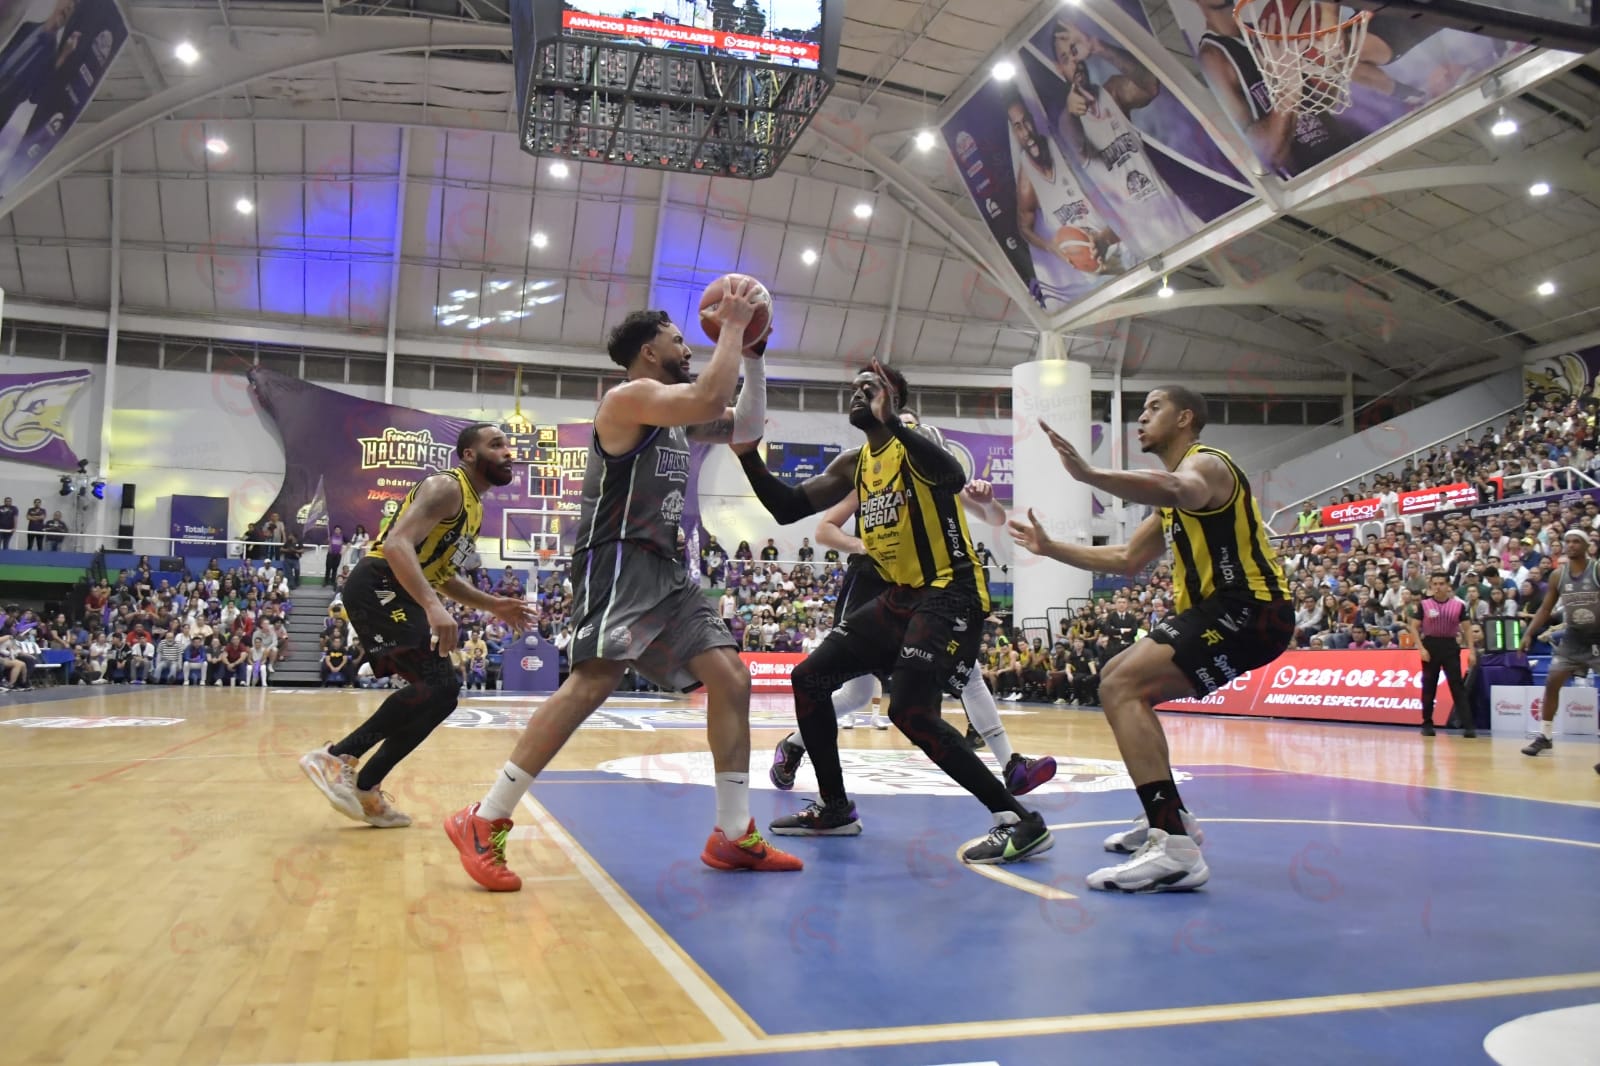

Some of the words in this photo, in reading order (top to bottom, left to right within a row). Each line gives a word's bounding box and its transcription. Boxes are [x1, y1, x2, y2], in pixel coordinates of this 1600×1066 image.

[626, 24, 715, 44] ESPECTACULARES
[366, 441, 447, 471] HALCONES
[860, 491, 905, 516] FUERZA
[1331, 503, 1381, 519] enfoqu
[863, 507, 899, 529] REGIA
[947, 517, 959, 549] coflex
[1264, 693, 1322, 706] ANUNCIOS
[1325, 695, 1424, 710] ESPECTACULAR
